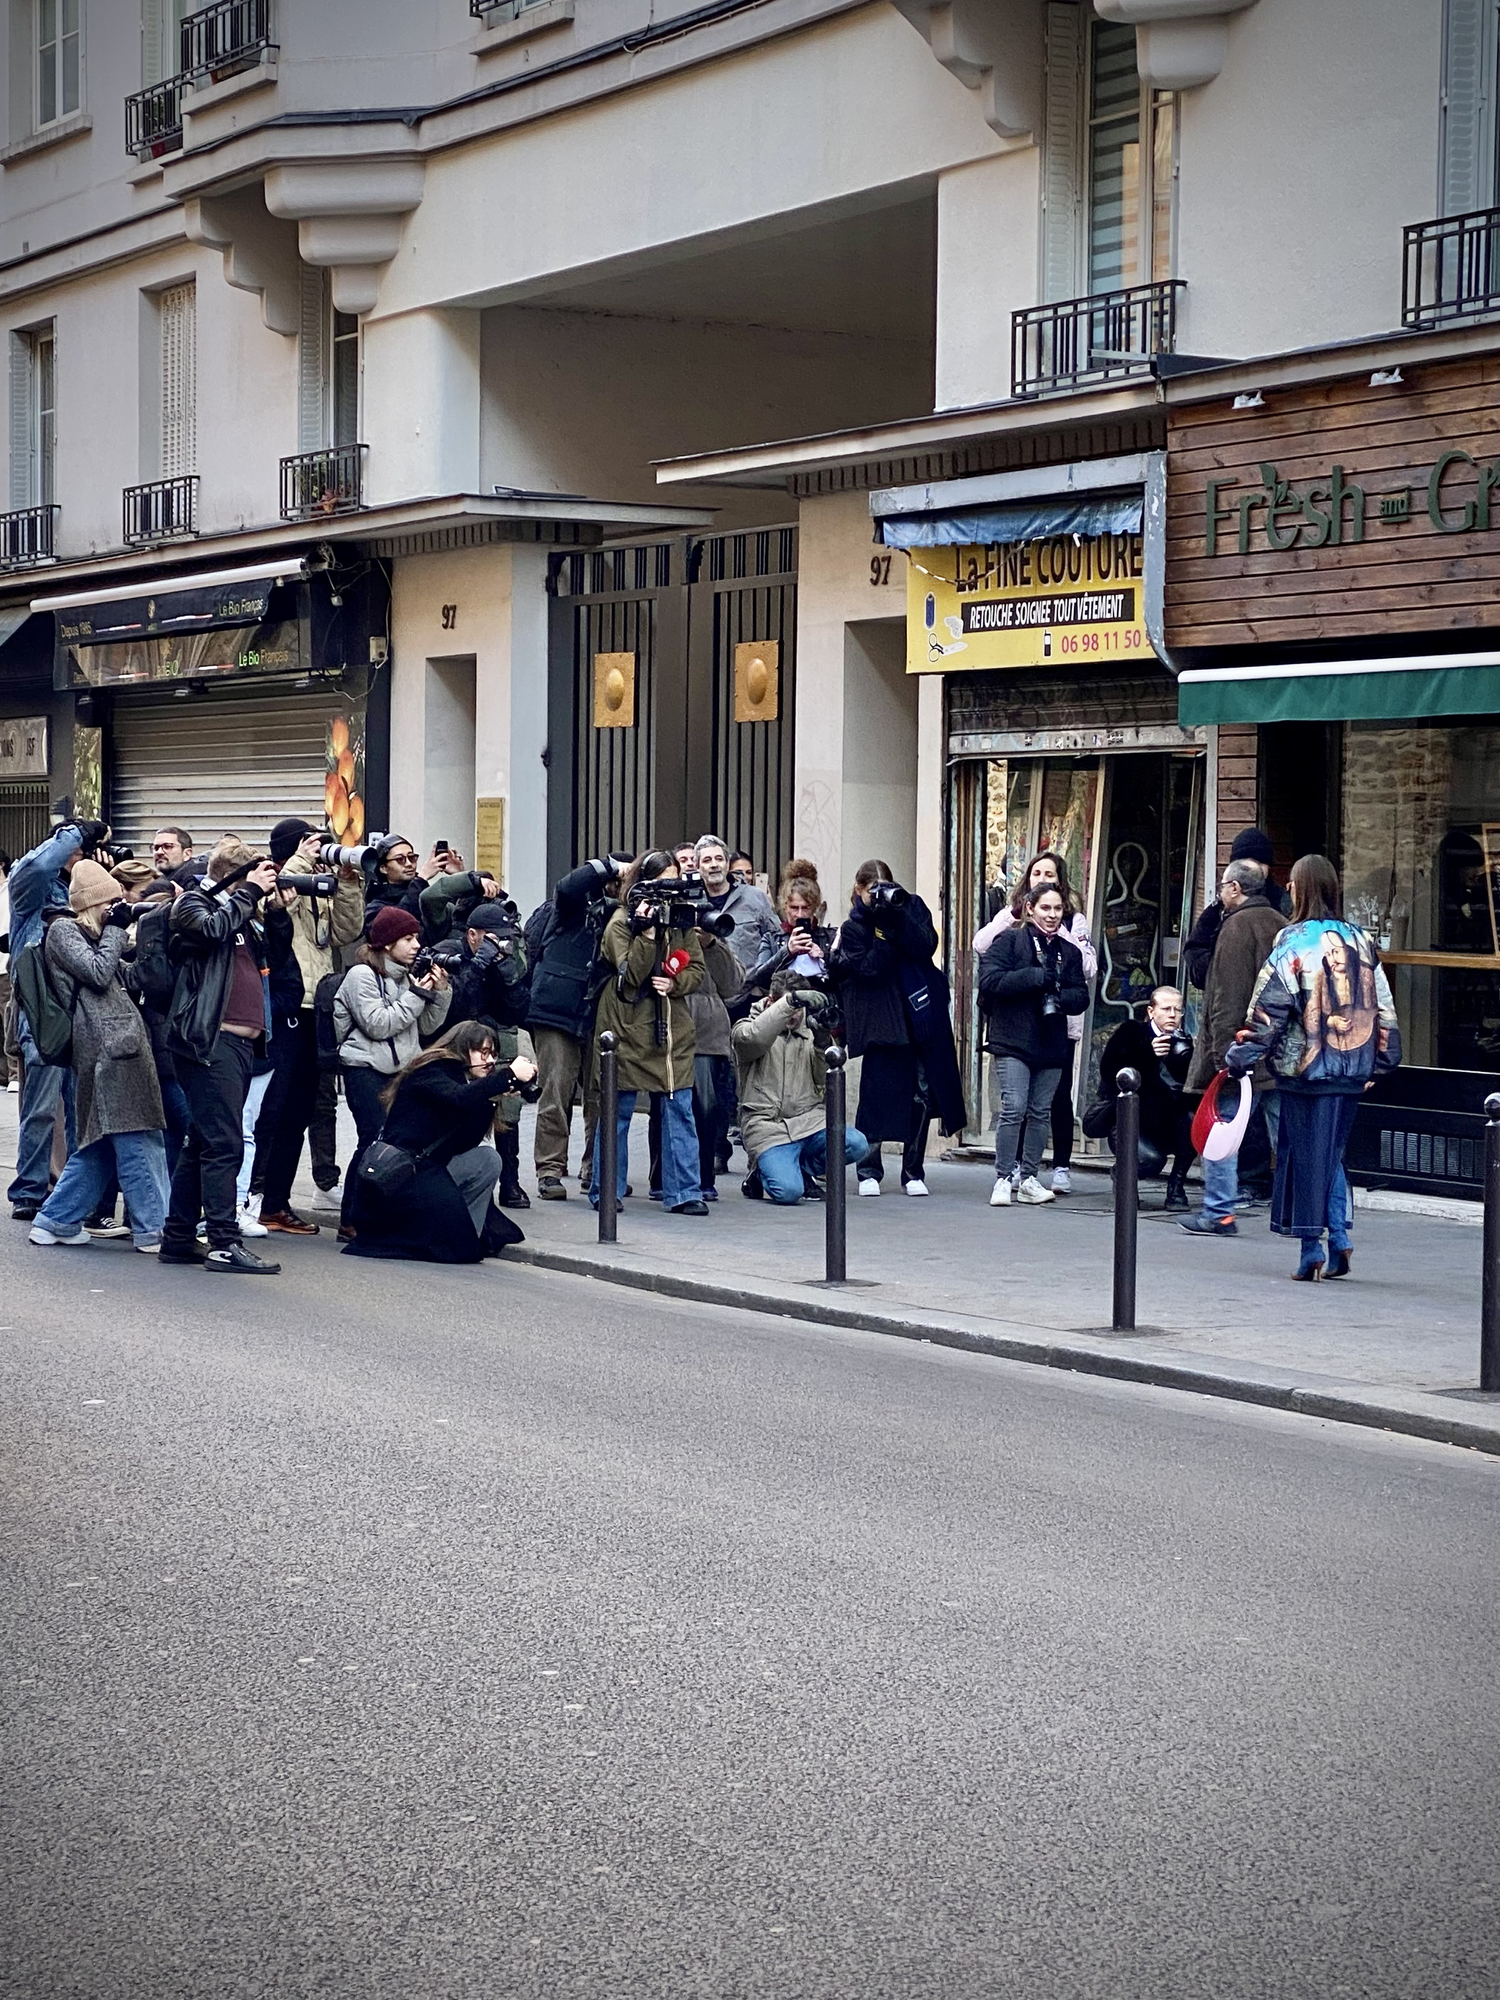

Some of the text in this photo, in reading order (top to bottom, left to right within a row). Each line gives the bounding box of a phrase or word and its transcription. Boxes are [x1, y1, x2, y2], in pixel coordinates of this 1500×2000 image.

[1205, 464, 1366, 557] Fresh
[869, 556, 892, 585] 97
[955, 532, 1143, 593] La FINE COUTURE
[441, 604, 457, 630] 97
[969, 592, 1124, 629] RETOUCHE SOIGNEE TOUT VÊTEMENT
[1061, 635, 1078, 654] 06
[1082, 633, 1099, 652] 98
[1104, 631, 1118, 650] 11
[1124, 629, 1141, 649] 50
[239, 652, 248, 667] Le
[248, 650, 260, 665] Bio
